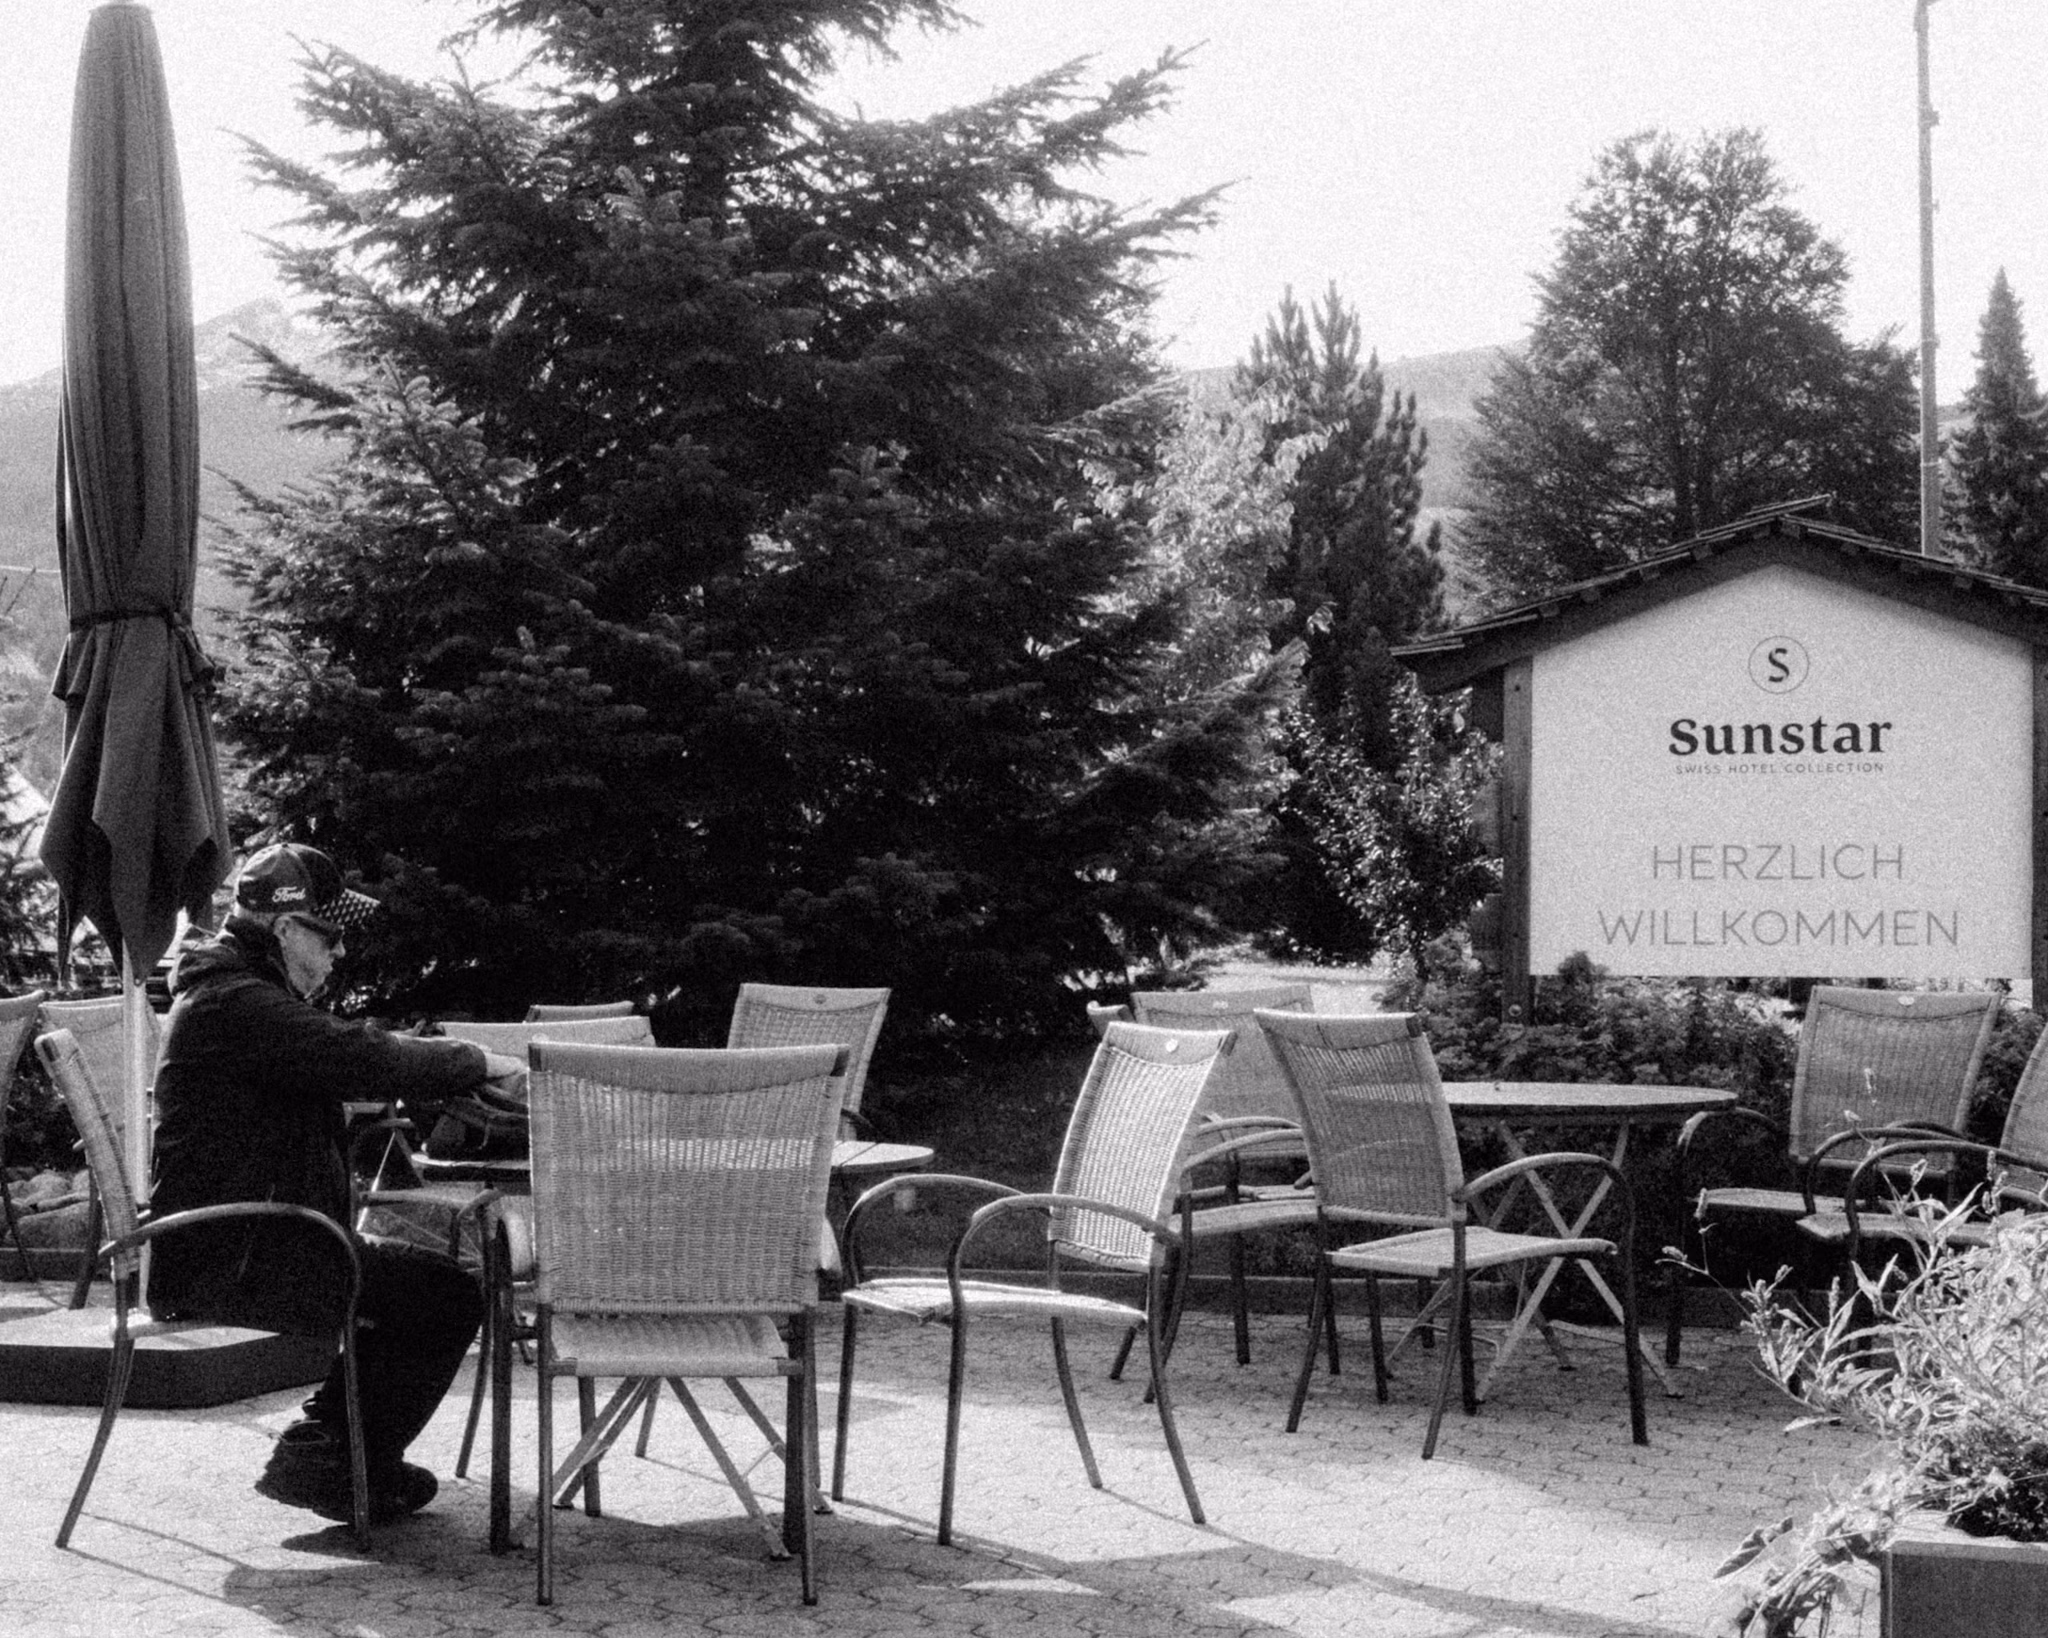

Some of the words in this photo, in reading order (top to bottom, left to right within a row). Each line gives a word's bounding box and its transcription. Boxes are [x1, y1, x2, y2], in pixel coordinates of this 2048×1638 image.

[1767, 647, 1791, 683] S
[1668, 715, 1893, 756] Sunstar
[1676, 763, 1722, 775] SWISS
[1728, 763, 1777, 775] HOTEL
[1784, 762, 1885, 774] COLLECTION
[1652, 844, 1904, 881] HERZLICH
[271, 886, 306, 903] Ford
[1598, 909, 1960, 947] WILLKOMMEN
